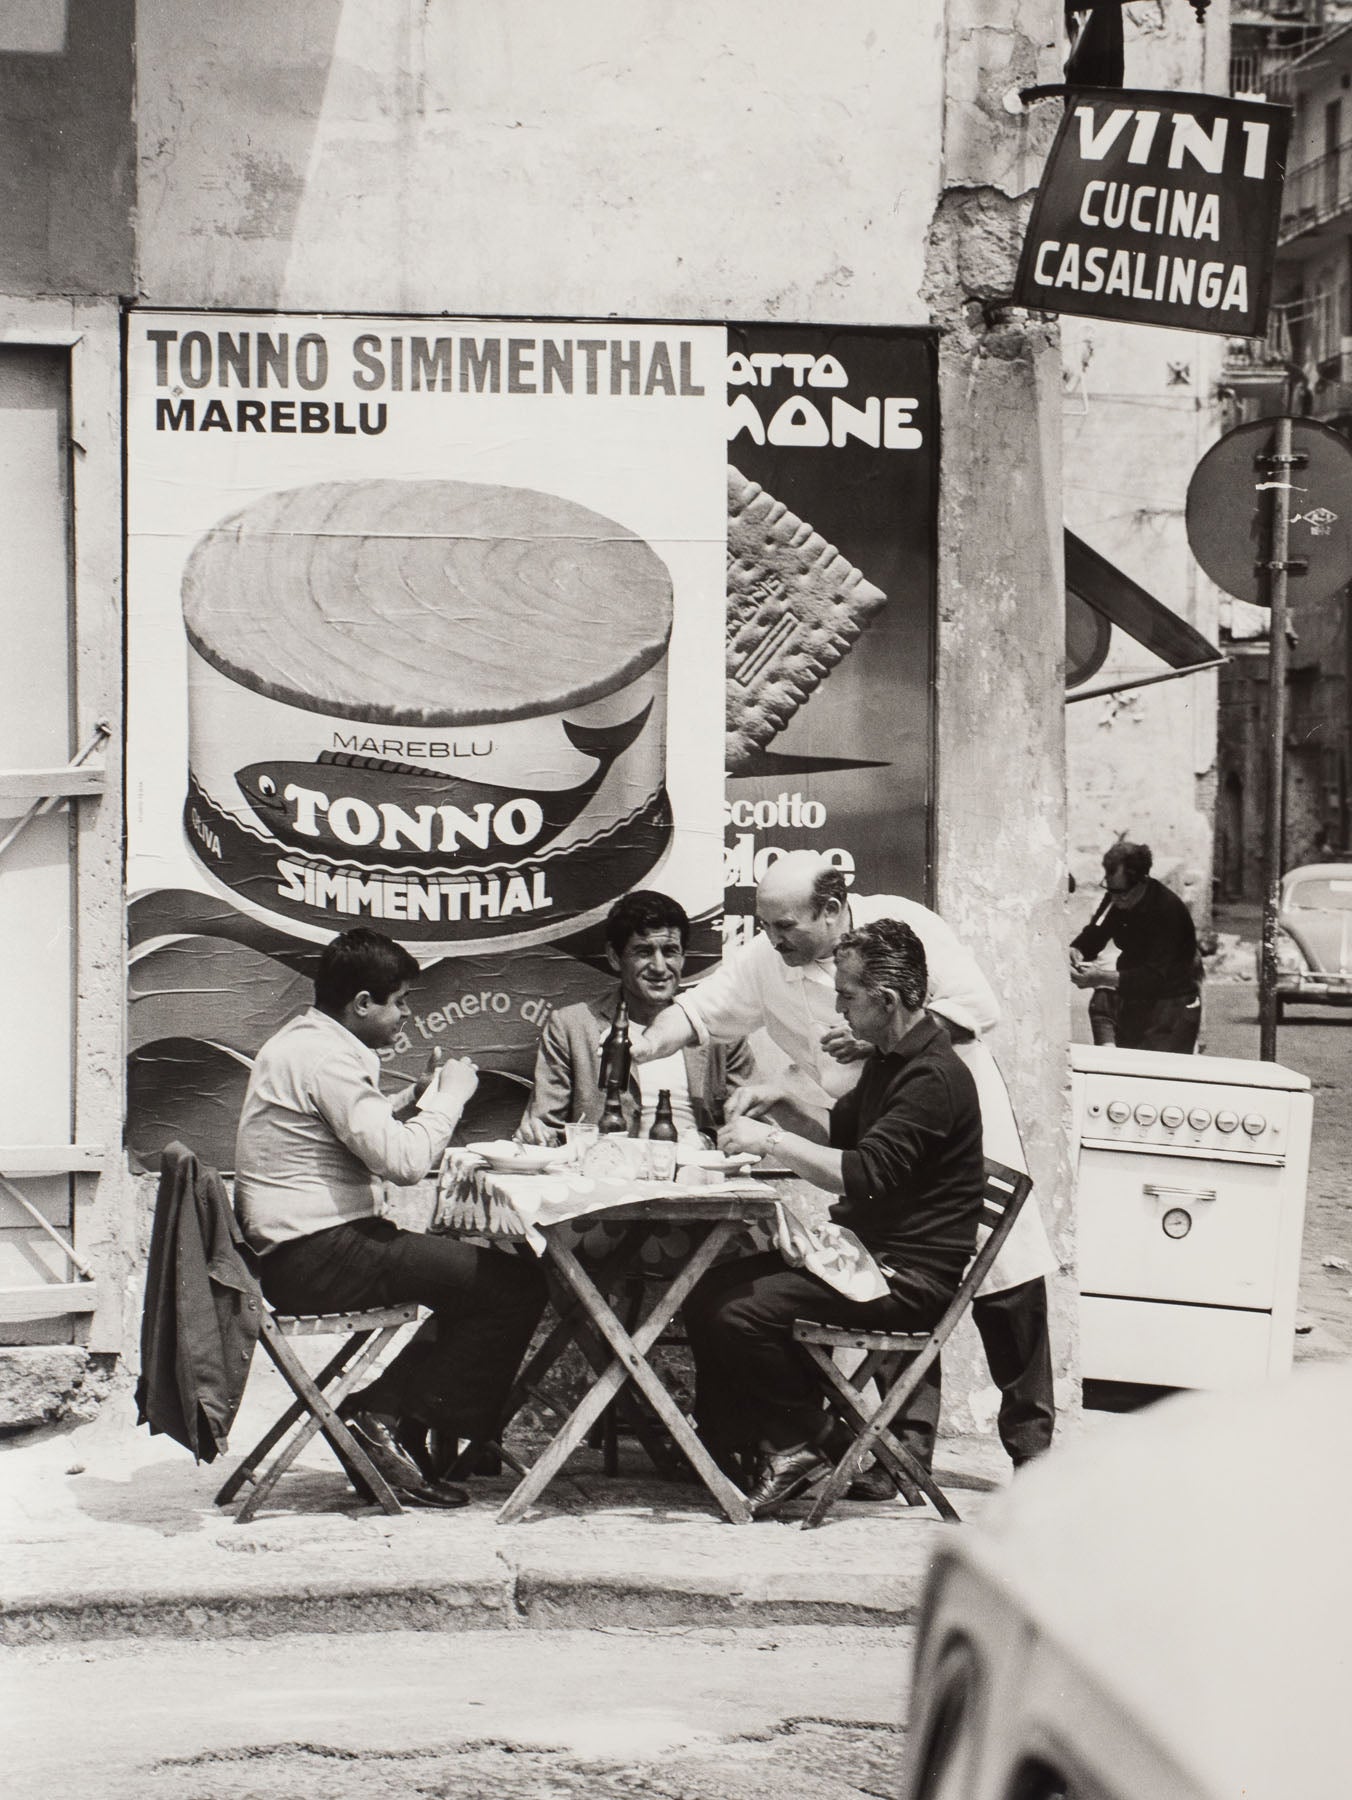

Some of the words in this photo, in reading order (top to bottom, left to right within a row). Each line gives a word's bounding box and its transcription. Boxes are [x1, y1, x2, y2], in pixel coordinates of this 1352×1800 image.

[1074, 106, 1270, 180] VINI
[1079, 180, 1220, 242] CUCINA
[1033, 240, 1249, 313] CASALINGA
[147, 329, 329, 392] TONNO
[352, 333, 705, 397] SIMMENTHAL
[155, 399, 388, 435] MAREBLU
[332, 731, 494, 758] MAREBLU
[285, 782, 544, 853] TONNO
[276, 855, 553, 922] SIMMENTHAL
[414, 991, 512, 1040] tenero
[520, 998, 553, 1027] di
